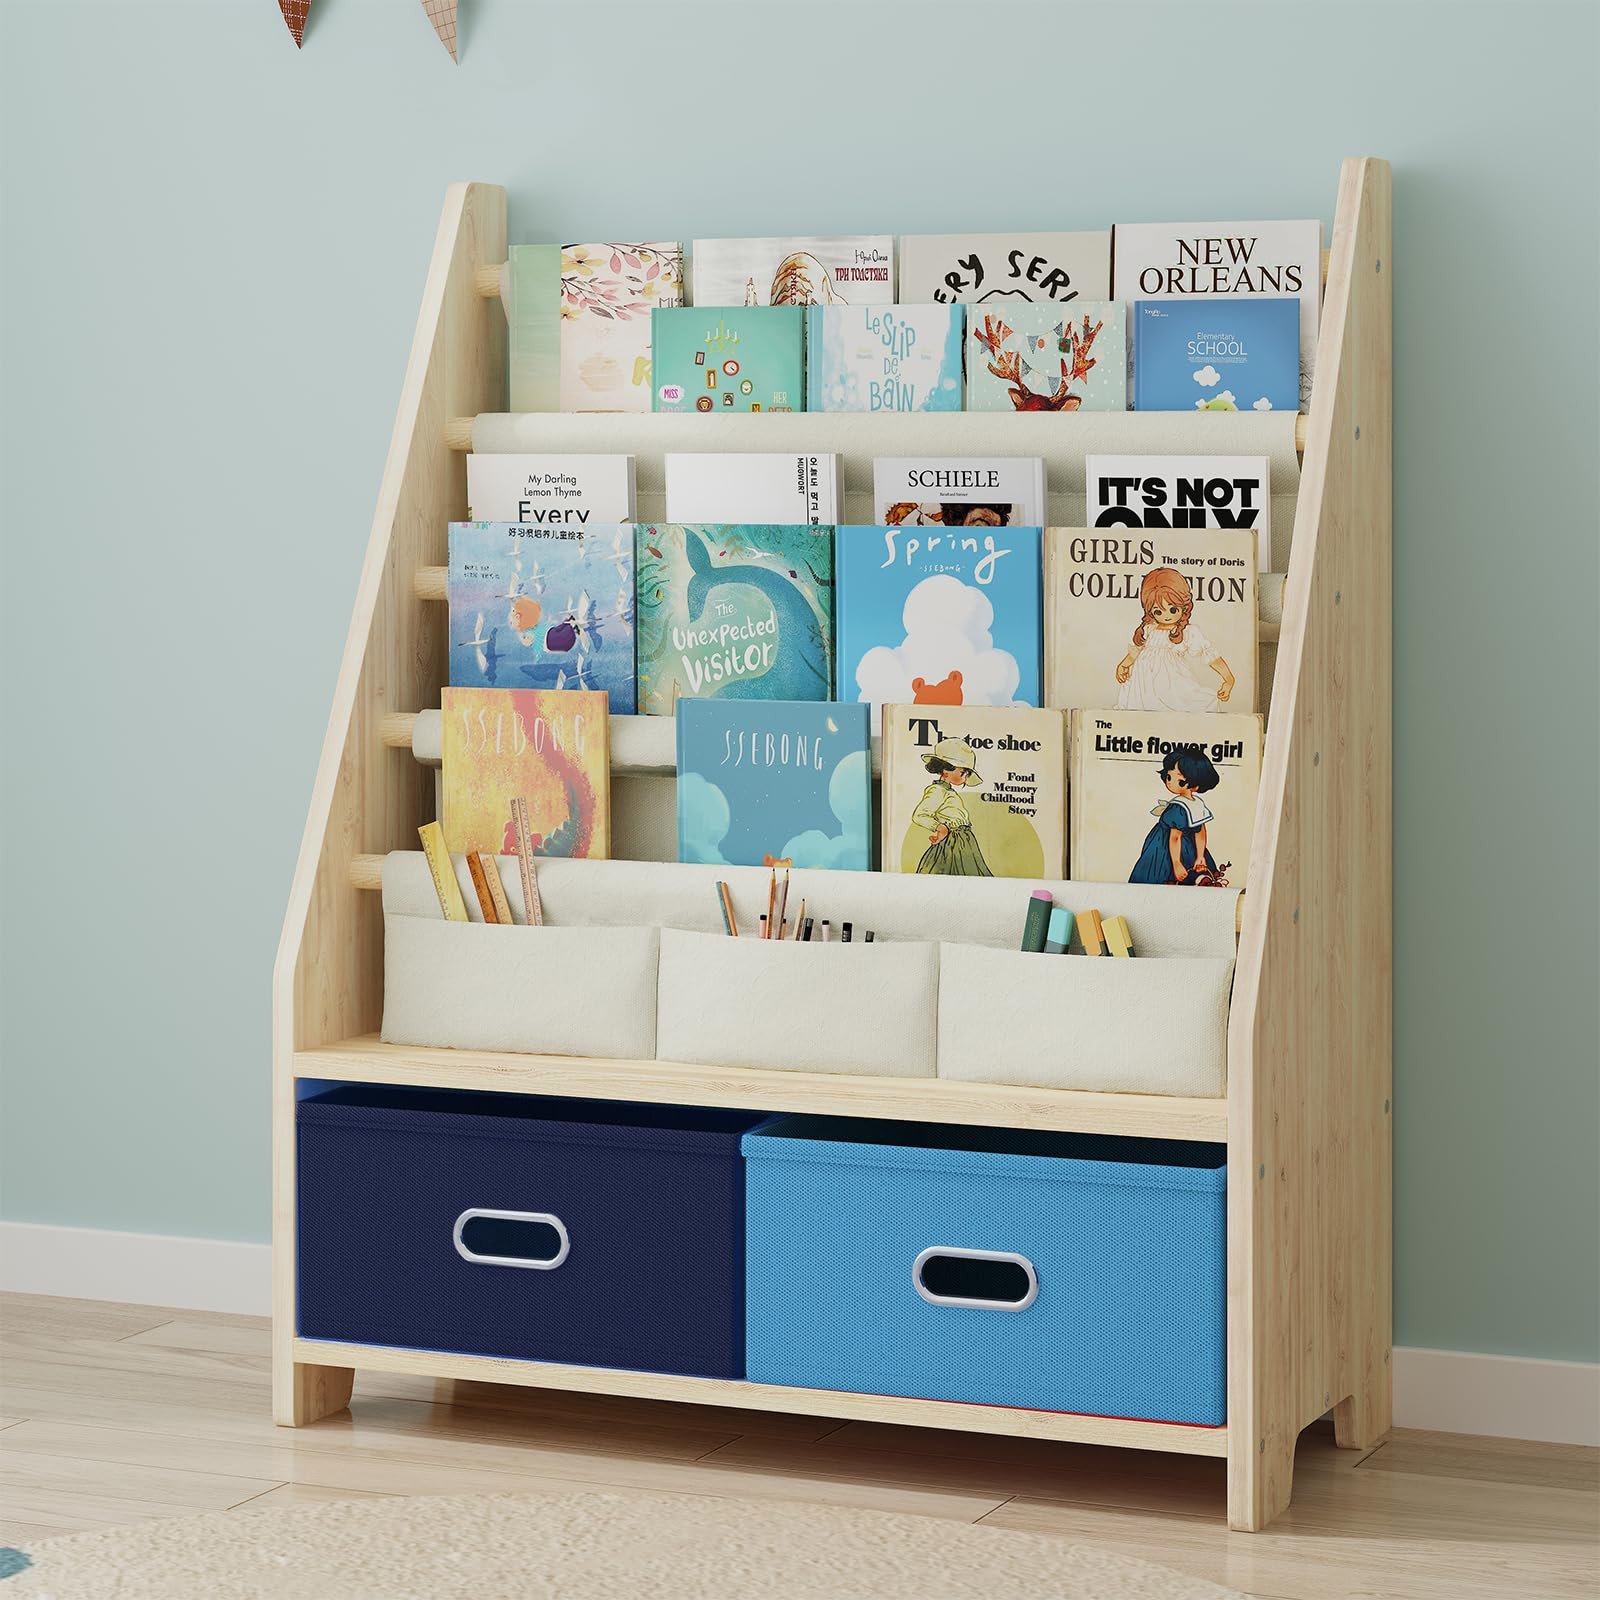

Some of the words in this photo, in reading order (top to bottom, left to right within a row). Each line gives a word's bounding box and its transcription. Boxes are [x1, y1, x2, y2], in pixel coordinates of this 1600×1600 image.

[1176, 237, 1258, 265] NEW
[1139, 264, 1303, 295] ORLEANS
[1196, 331, 1235, 341] Elementary
[1187, 341, 1248, 356] SCHOOL
[528, 474, 542, 485] My
[544, 473, 577, 486] Darling
[797, 457, 805, 495] MUGWORT
[907, 470, 1000, 488] SCHIELE
[524, 487, 552, 497] Lemon
[554, 486, 582, 499] Thyme
[1098, 477, 1168, 507] IT'S
[1176, 477, 1260, 508] NOT
[880, 529, 1012, 585] Spring
[1069, 538, 1155, 566] GIRLS
[1161, 556, 1179, 565] The
[1181, 556, 1205, 568] story
[1207, 556, 1218, 566] of
[1219, 557, 1246, 567] Doris
[1069, 572, 1247, 603] COLLION
[714, 602, 735, 616] The
[672, 610, 776, 651] Unexpected
[1095, 720, 1113, 729] The
[720, 730, 824, 770] SSEBONG
[963, 733, 994, 750] toe
[997, 734, 1042, 752] shoe
[1095, 734, 1144, 754] Little
[1211, 740, 1243, 763] girl
[1007, 772, 1036, 783] Fond
[993, 782, 1038, 796] Memory
[980, 792, 1035, 805] Childhood
[1008, 804, 1038, 818] Story
